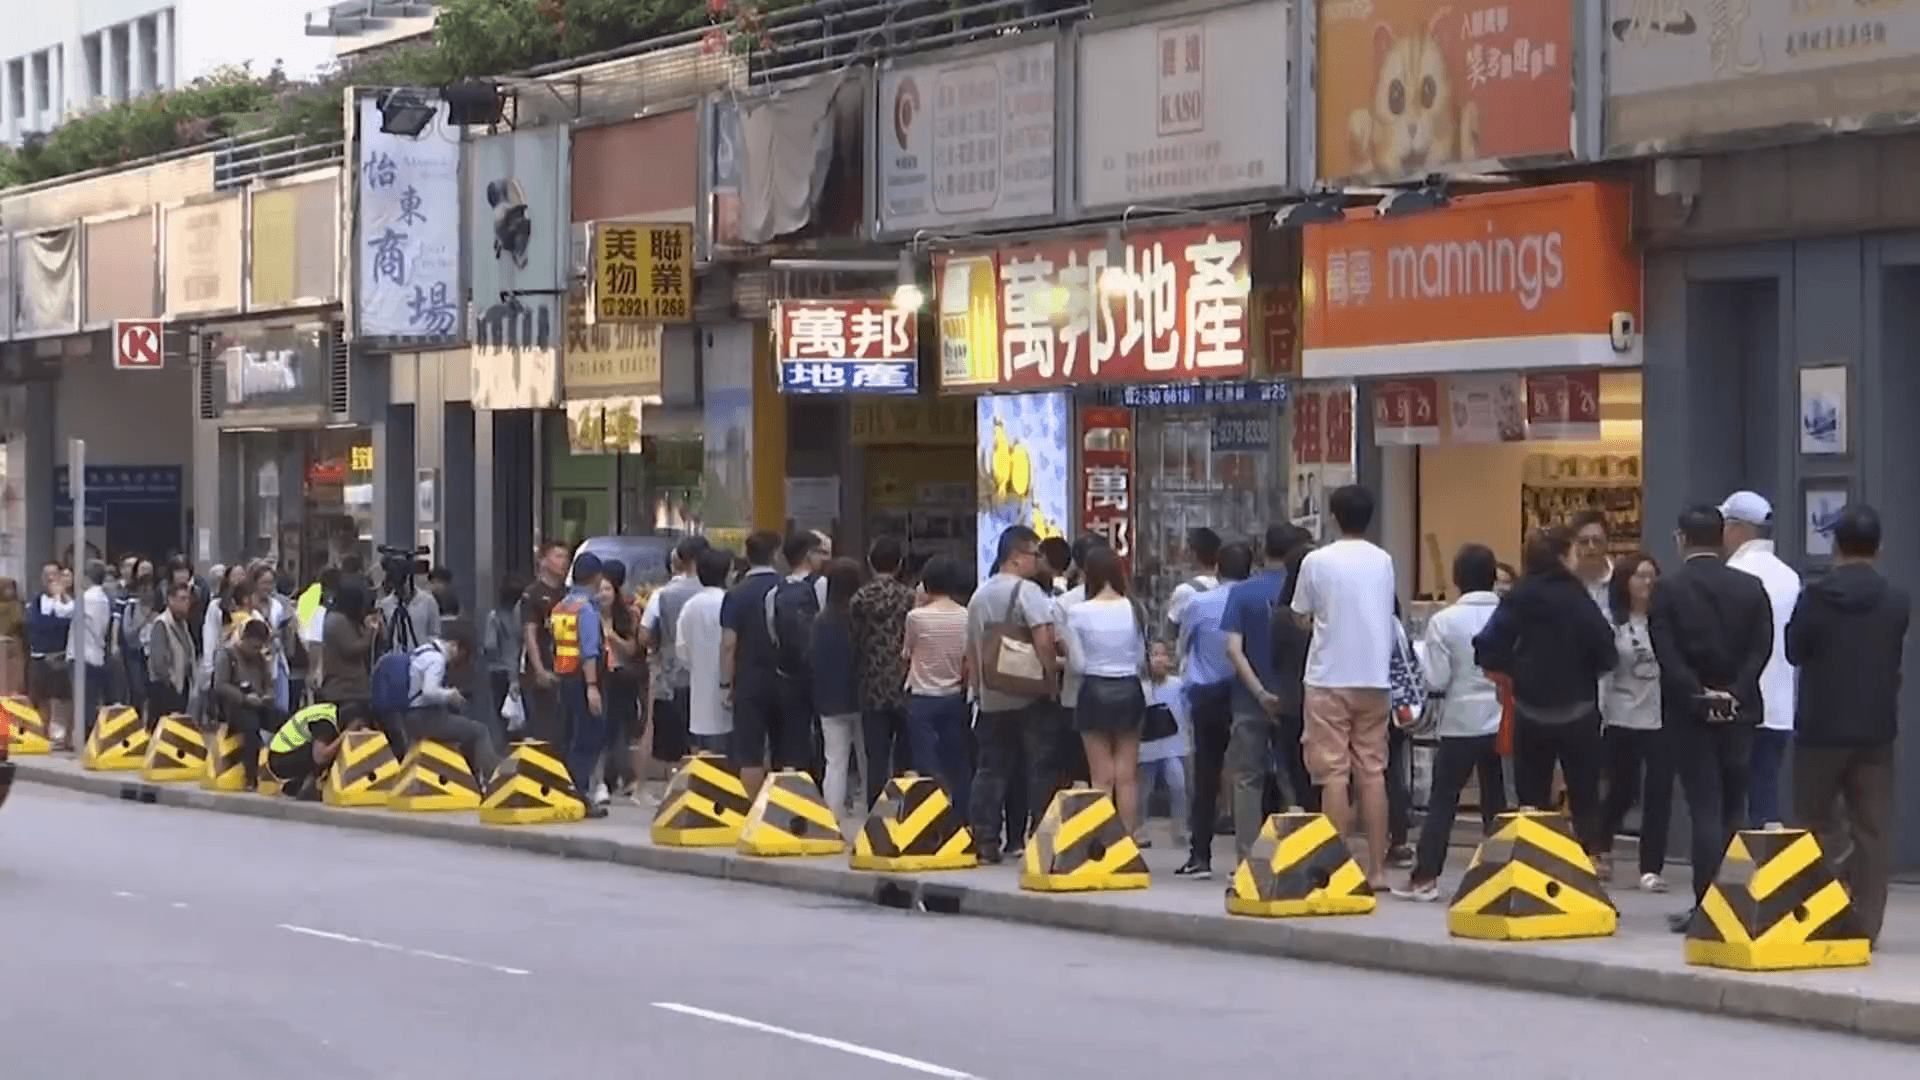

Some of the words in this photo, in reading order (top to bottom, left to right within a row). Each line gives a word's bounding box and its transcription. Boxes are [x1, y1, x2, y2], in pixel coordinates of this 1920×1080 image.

[363, 151, 457, 337] 怡東商場
[605, 228, 682, 261] 美聯
[605, 262, 682, 295] 物業
[1387, 221, 1564, 310] mannings
[617, 298, 649, 316] 2921
[1002, 233, 1248, 381] 萬邦地產
[128, 330, 154, 362] K
[787, 307, 911, 358] 萬邦
[788, 362, 909, 388] 地產
[1085, 464, 1129, 557] 萬邦
